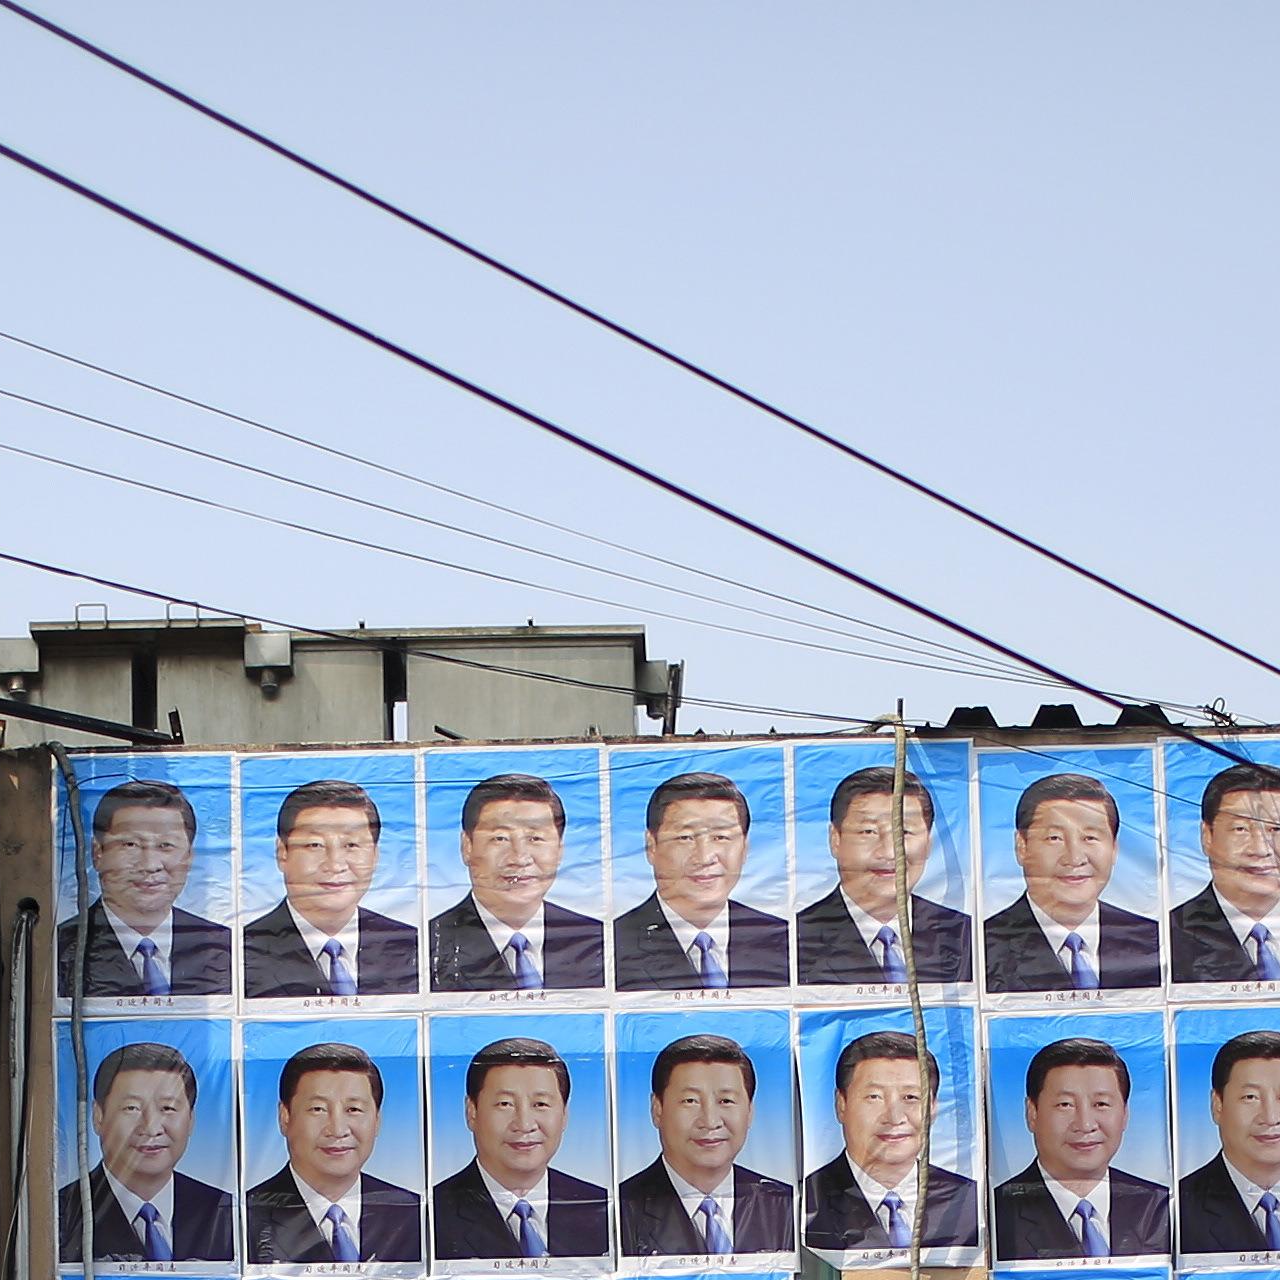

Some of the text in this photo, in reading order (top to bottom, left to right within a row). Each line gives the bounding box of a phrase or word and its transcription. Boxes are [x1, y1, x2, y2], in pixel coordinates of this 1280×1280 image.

[488, 990, 549, 1002] 习近平同志
[673, 990, 734, 1001] 习近平同志
[856, 985, 909, 995] 习近平同
[1044, 990, 1105, 1002] 习近平同志
[115, 997, 176, 1008] 习近平同志
[302, 996, 363, 1008] 习近平同志
[678, 1254, 739, 1267] 习近平同志
[862, 1249, 908, 1260] 习近平同
[117, 1261, 178, 1274] 习近平同志
[304, 1262, 365, 1275] 习近平同志
[492, 1259, 553, 1270] 习近平同志
